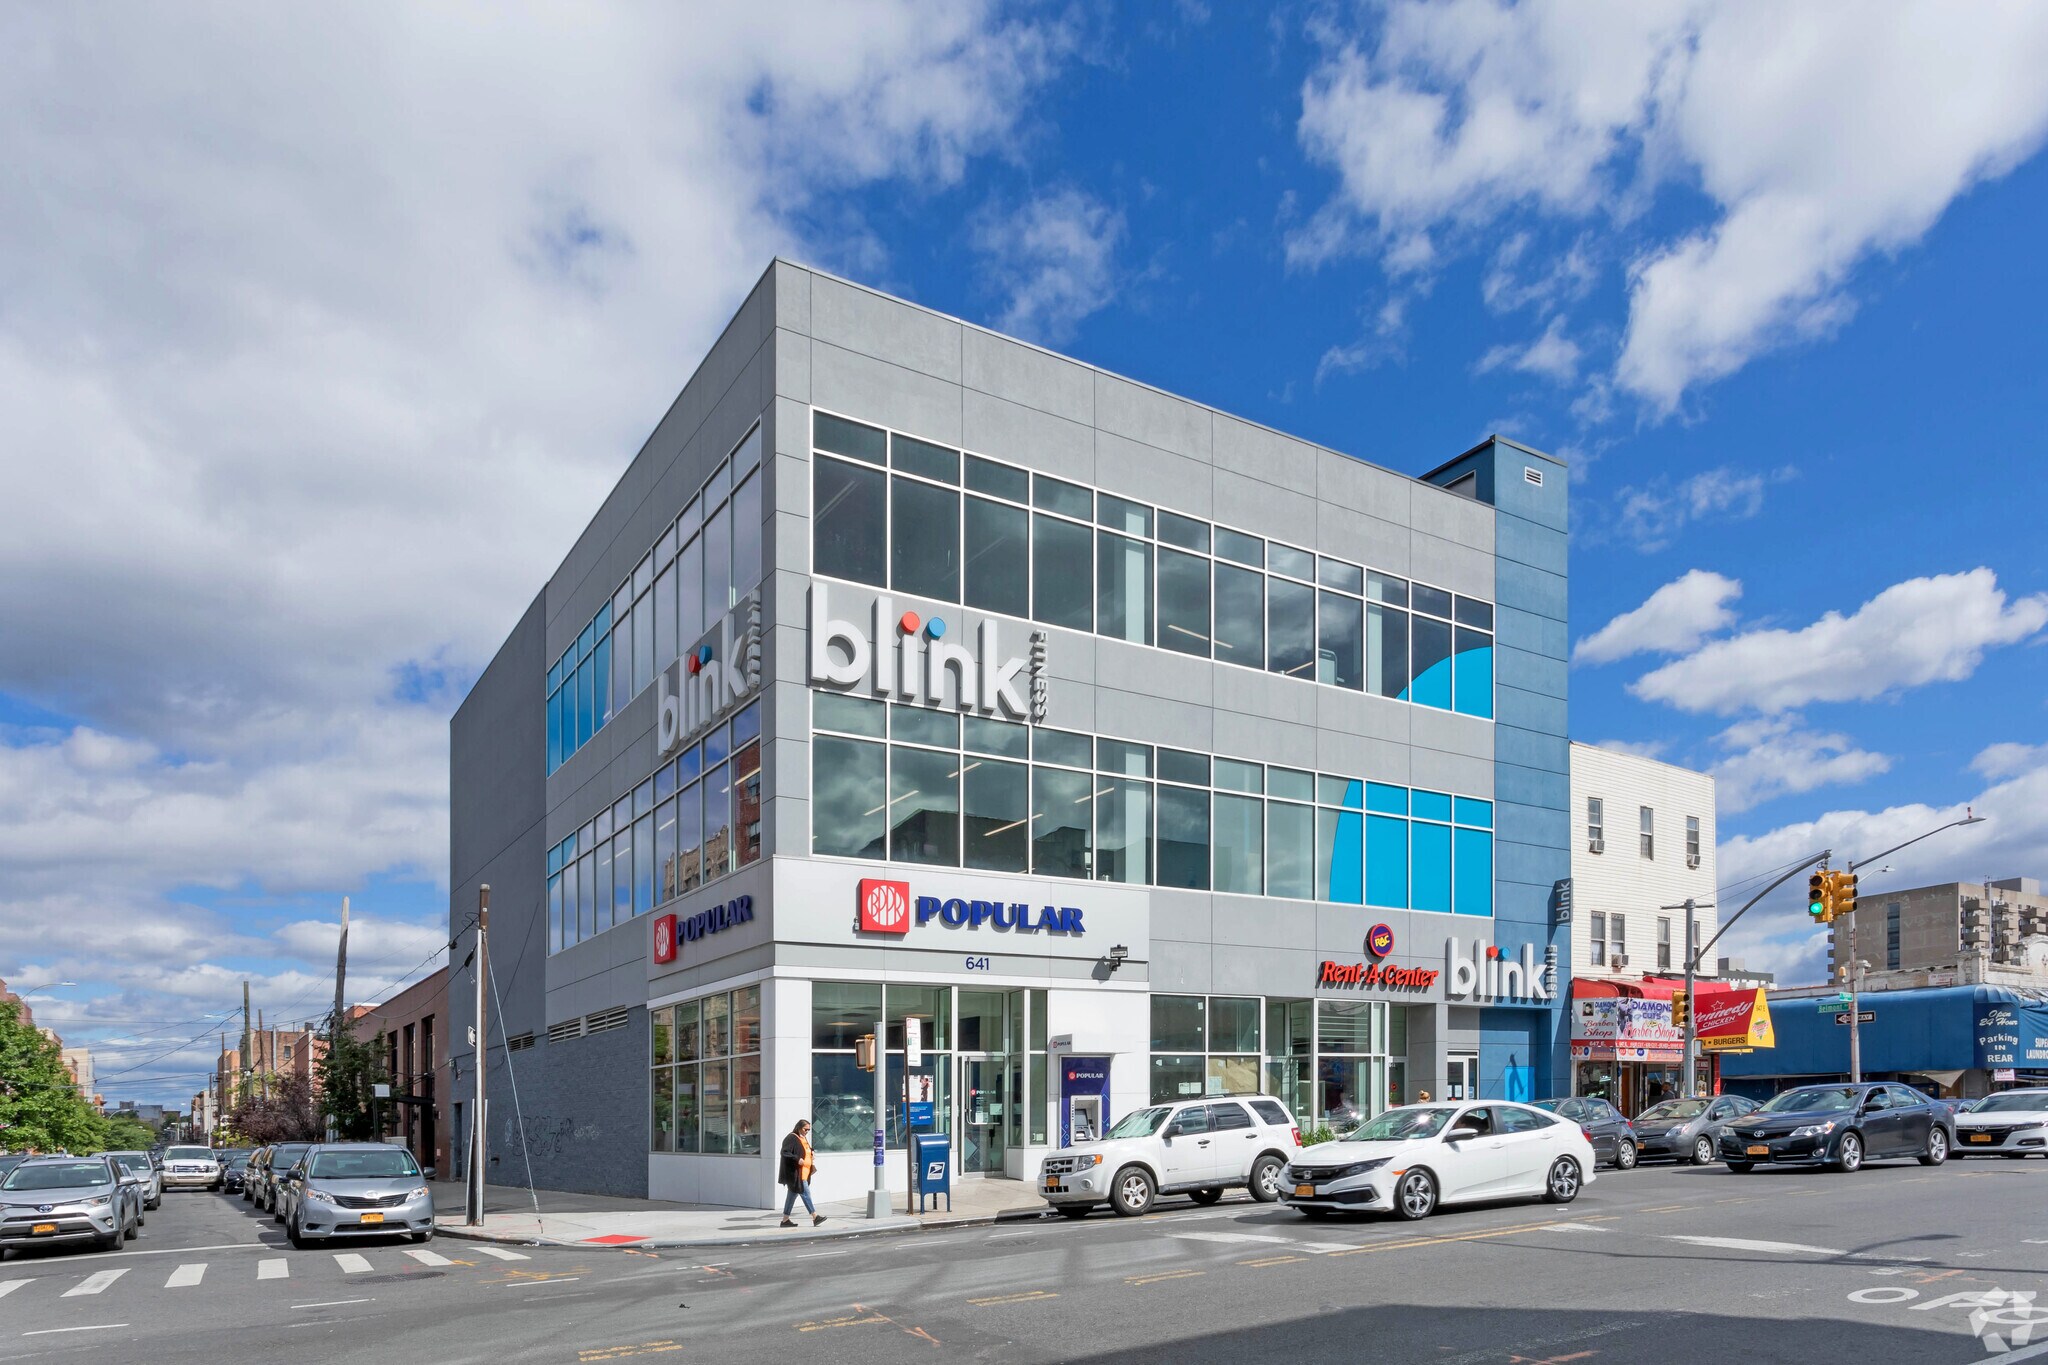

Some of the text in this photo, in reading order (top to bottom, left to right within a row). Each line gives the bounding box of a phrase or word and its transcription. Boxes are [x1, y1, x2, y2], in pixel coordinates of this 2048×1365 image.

[811, 581, 1029, 717] blink
[1033, 629, 1048, 718] FITNESS
[658, 612, 750, 757] blink
[1556, 881, 1570, 921] blink
[676, 894, 753, 946] POPULAR
[918, 896, 1085, 932] POPULAR
[965, 957, 990, 970] 641
[1450, 937, 1548, 999] blink
[1549, 944, 1558, 999] FITNESS
[1819, 1004, 1843, 1012] Belmont
[1988, 1010, 2011, 1018] Open
[1702, 1015, 1735, 1028] CHICKEN
[1979, 1018, 1994, 1026] 24
[1584, 1028, 1613, 1038] Shop
[1655, 1022, 1677, 1040] Shop
[1979, 1033, 2018, 1045] Parking
[1713, 1037, 1745, 1046] BURGERS
